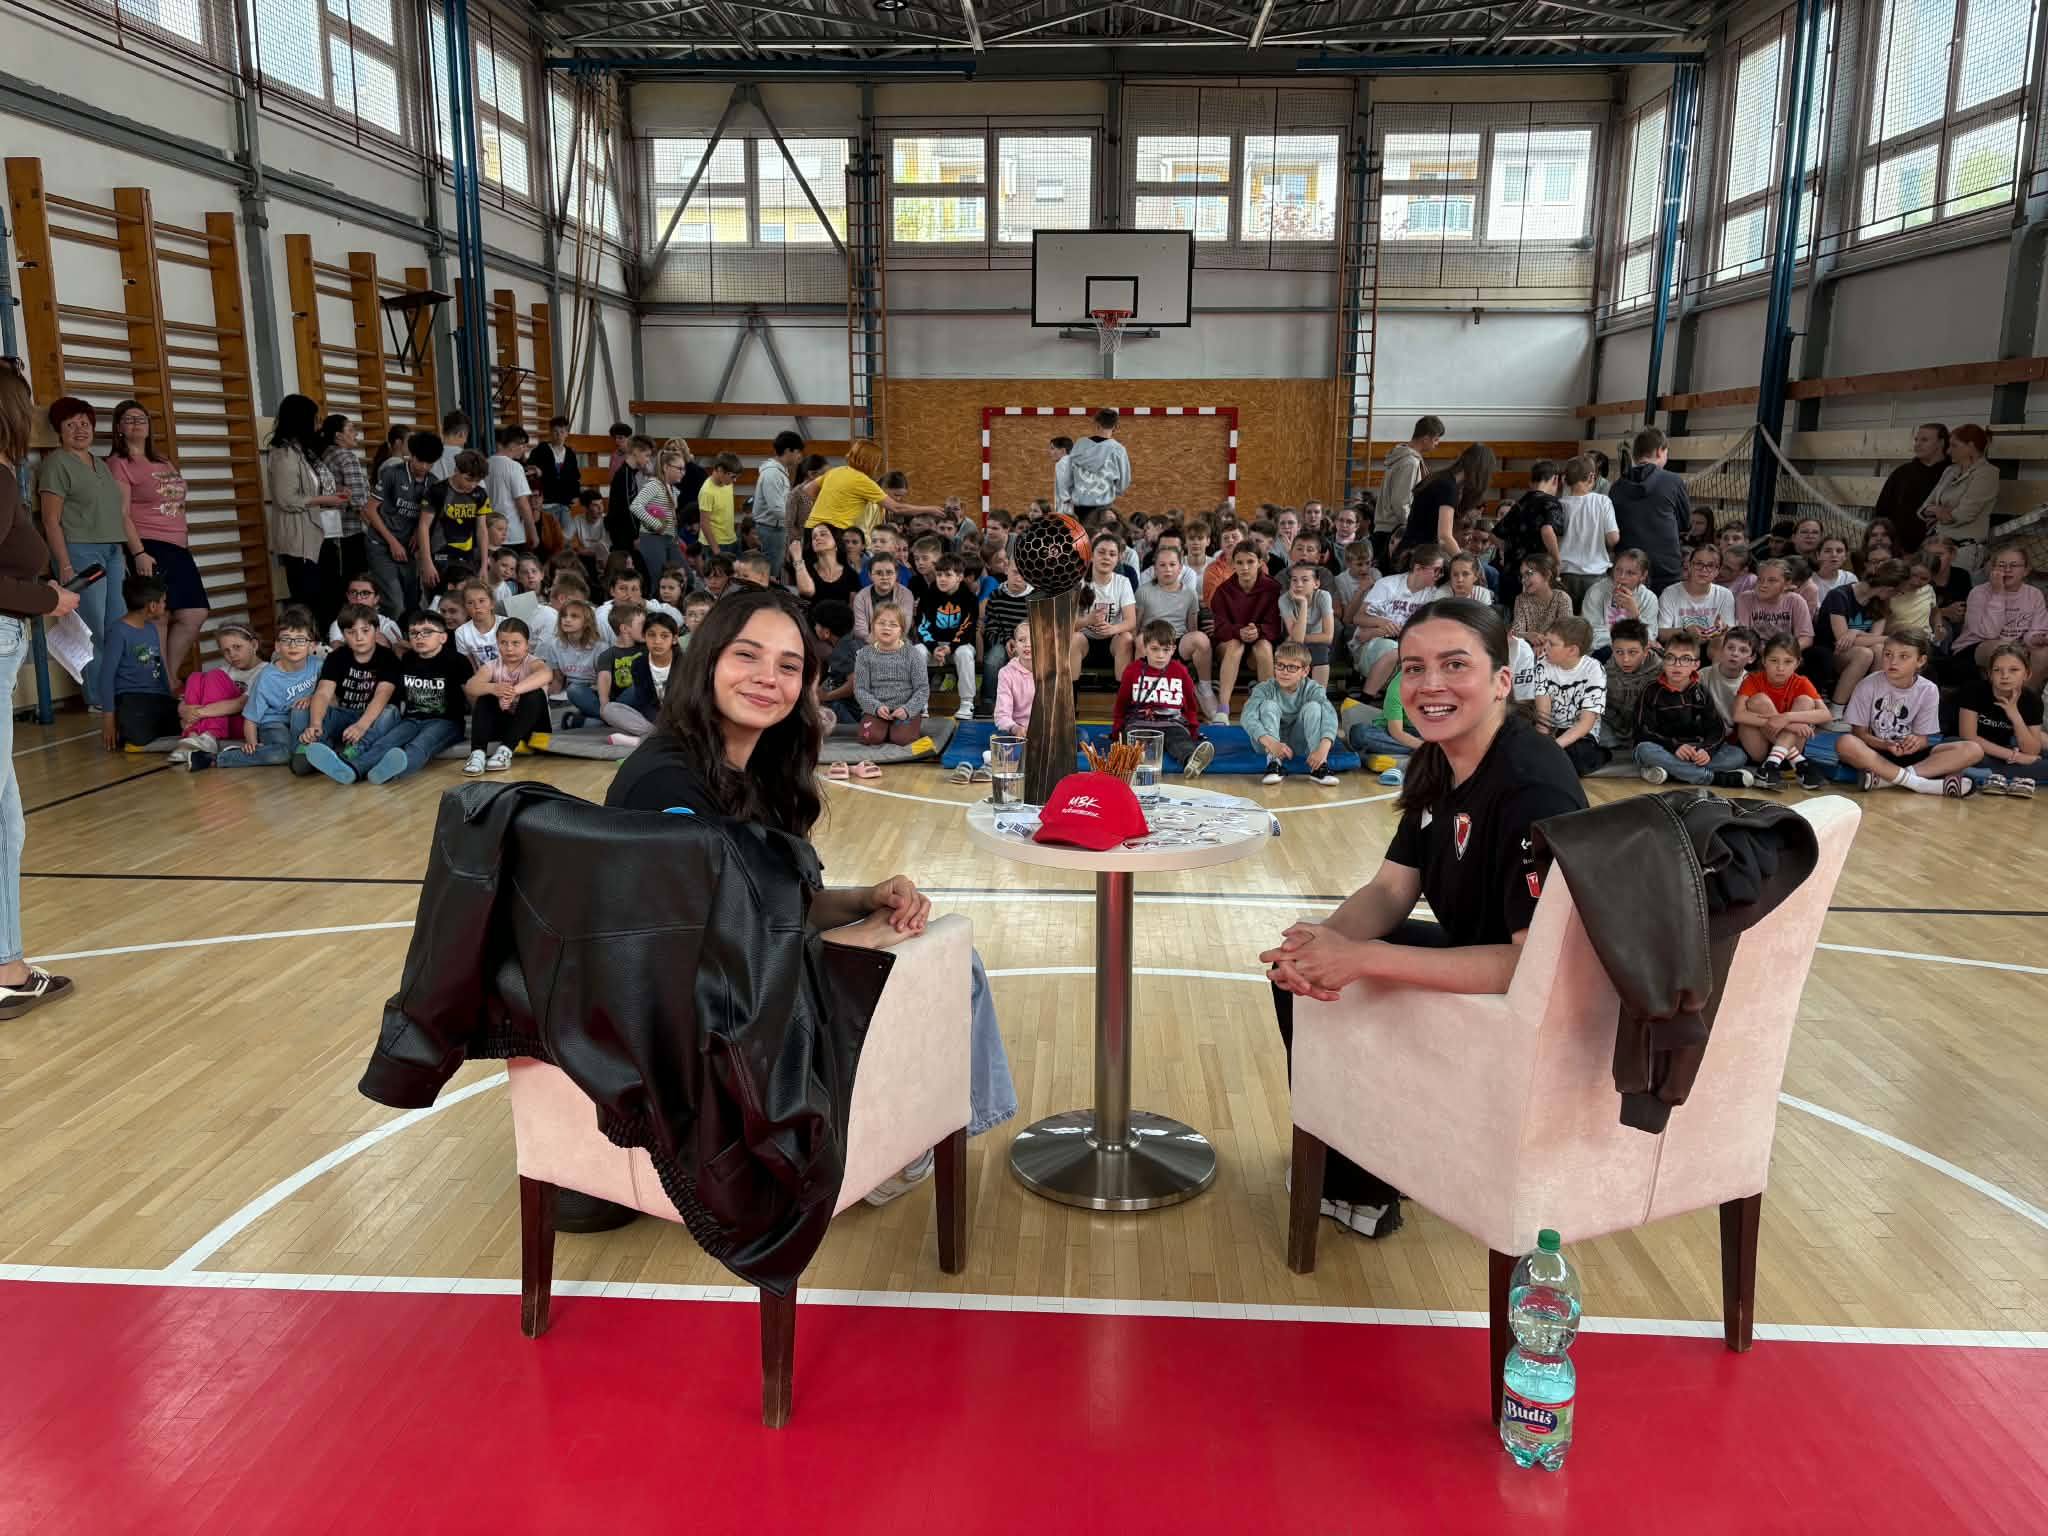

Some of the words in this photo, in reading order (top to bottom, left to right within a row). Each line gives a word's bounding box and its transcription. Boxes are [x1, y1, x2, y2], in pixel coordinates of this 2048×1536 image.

[404, 675, 446, 690] WORLD
[1514, 674, 1534, 685] GO
[1132, 688, 1184, 706] WARS
[1068, 795, 1102, 809] MBK
[1504, 1399, 1553, 1425] Budiš
